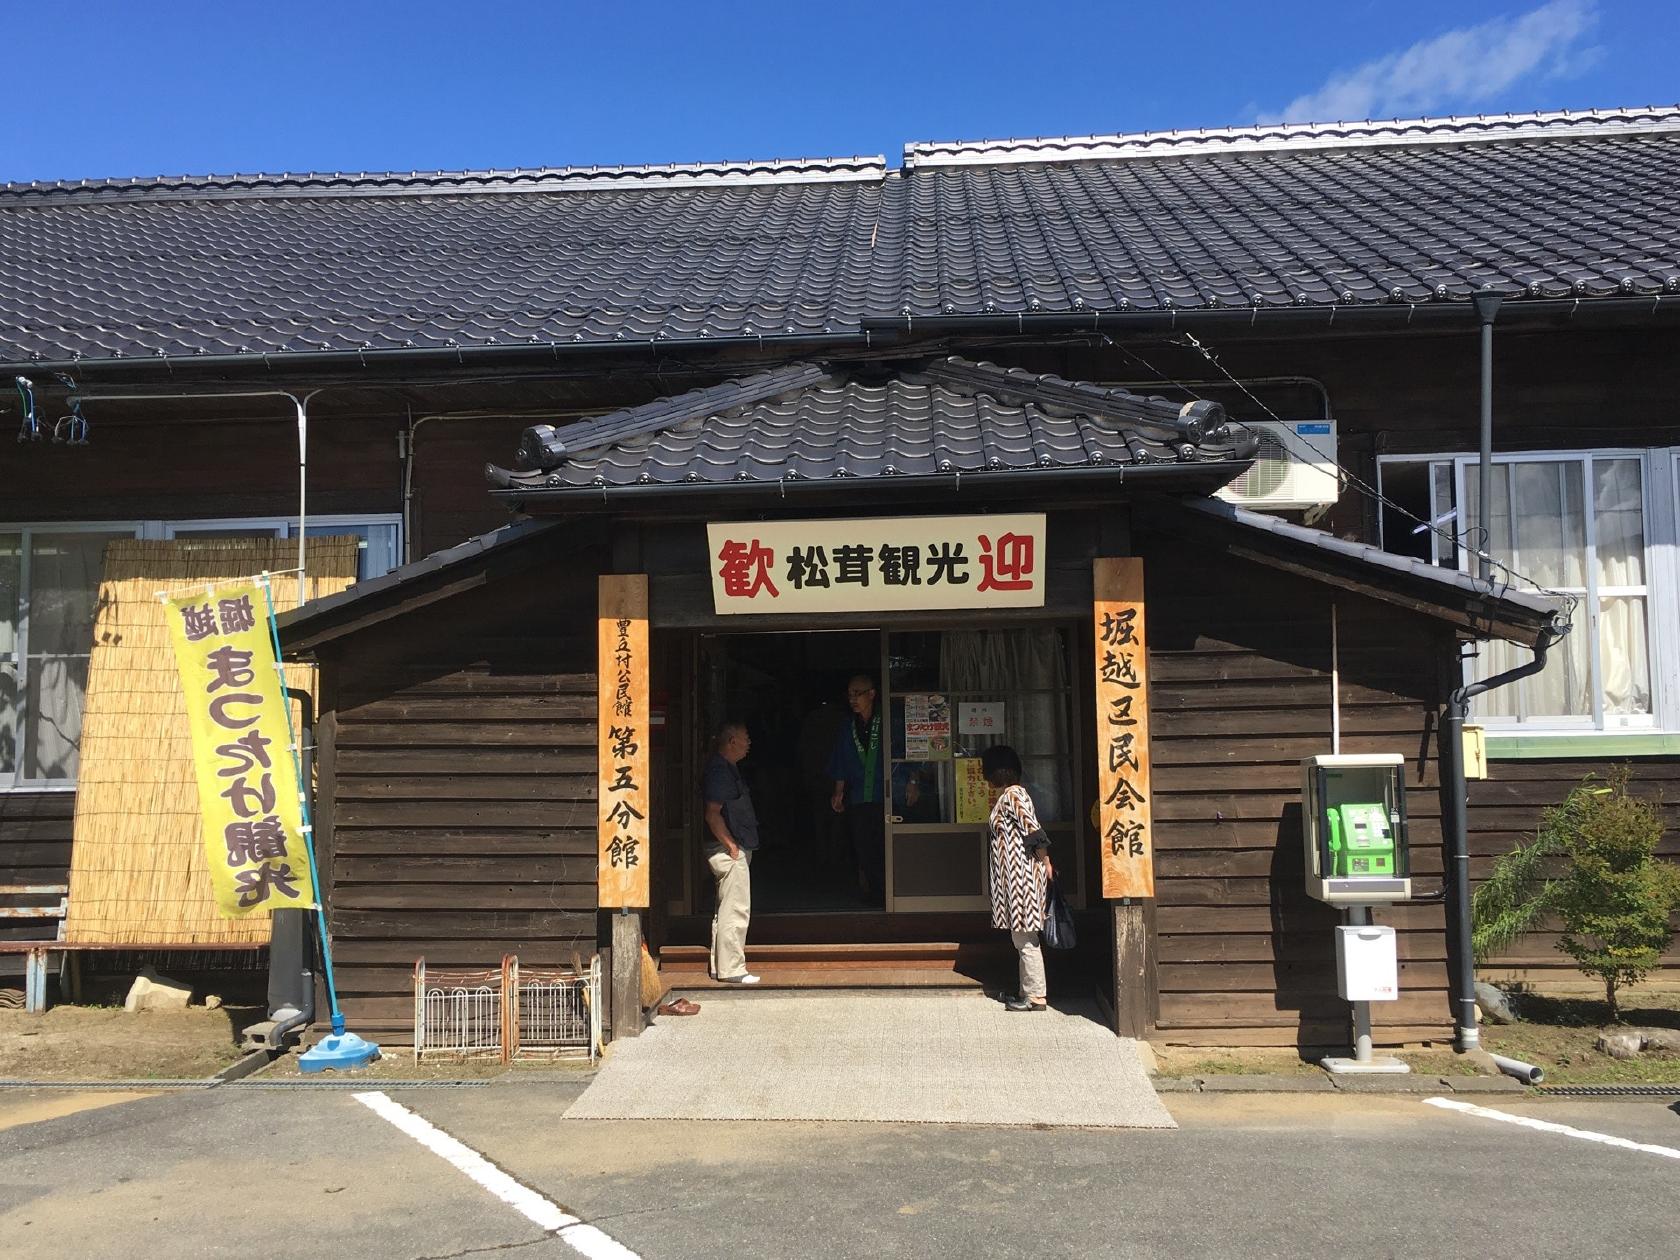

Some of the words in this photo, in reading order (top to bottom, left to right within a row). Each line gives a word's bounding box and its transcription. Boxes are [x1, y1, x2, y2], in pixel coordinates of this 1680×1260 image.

[1099, 608, 1146, 858] 堀越区民会館
